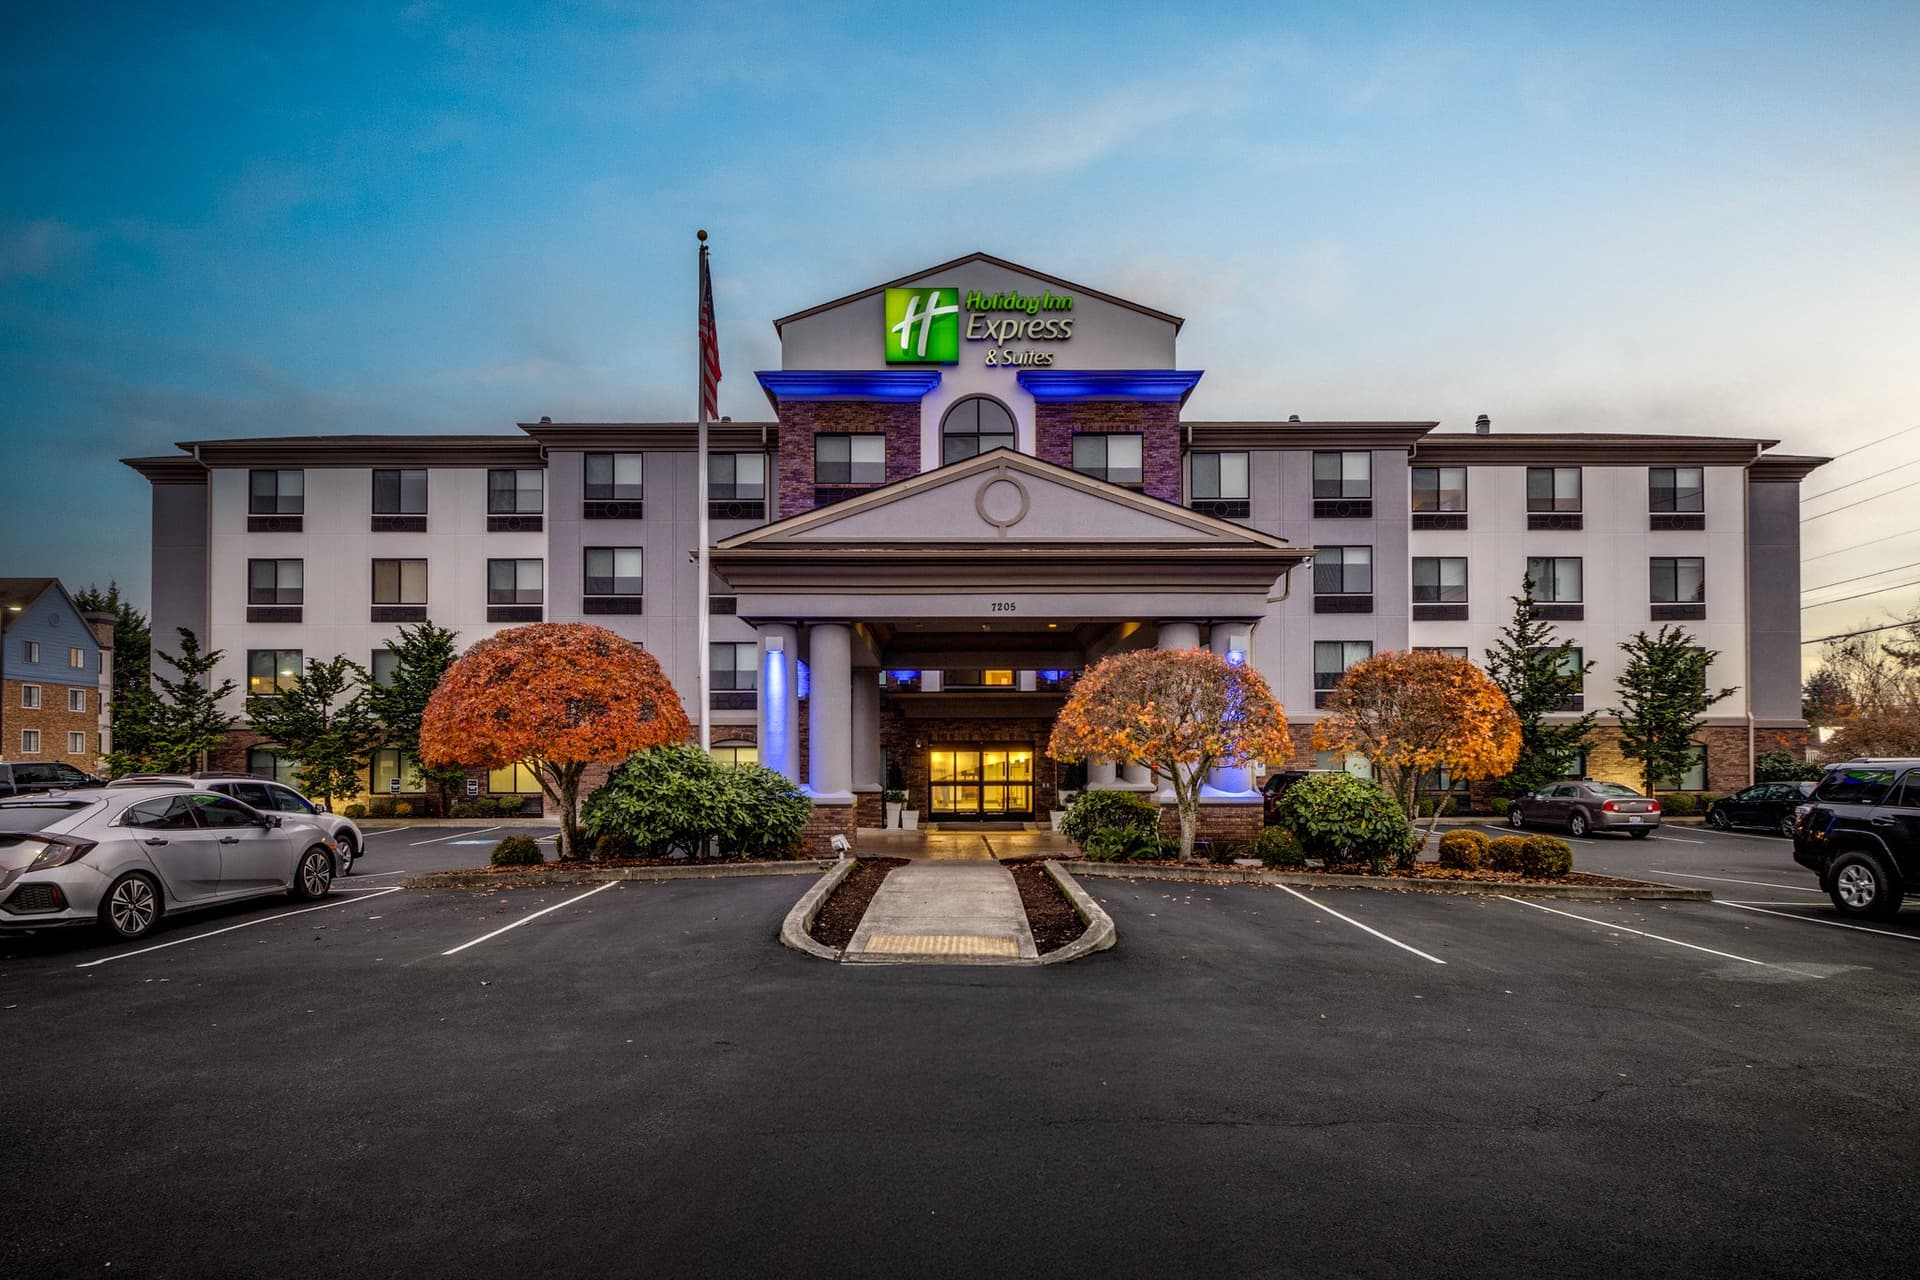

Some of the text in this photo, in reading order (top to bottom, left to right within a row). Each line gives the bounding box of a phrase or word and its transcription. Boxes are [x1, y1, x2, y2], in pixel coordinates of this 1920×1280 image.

[965, 289, 1073, 315] Holiday Inn
[966, 312, 1073, 347] Express
[985, 349, 1053, 366] & Suites
[991, 602, 1017, 612] 7205
